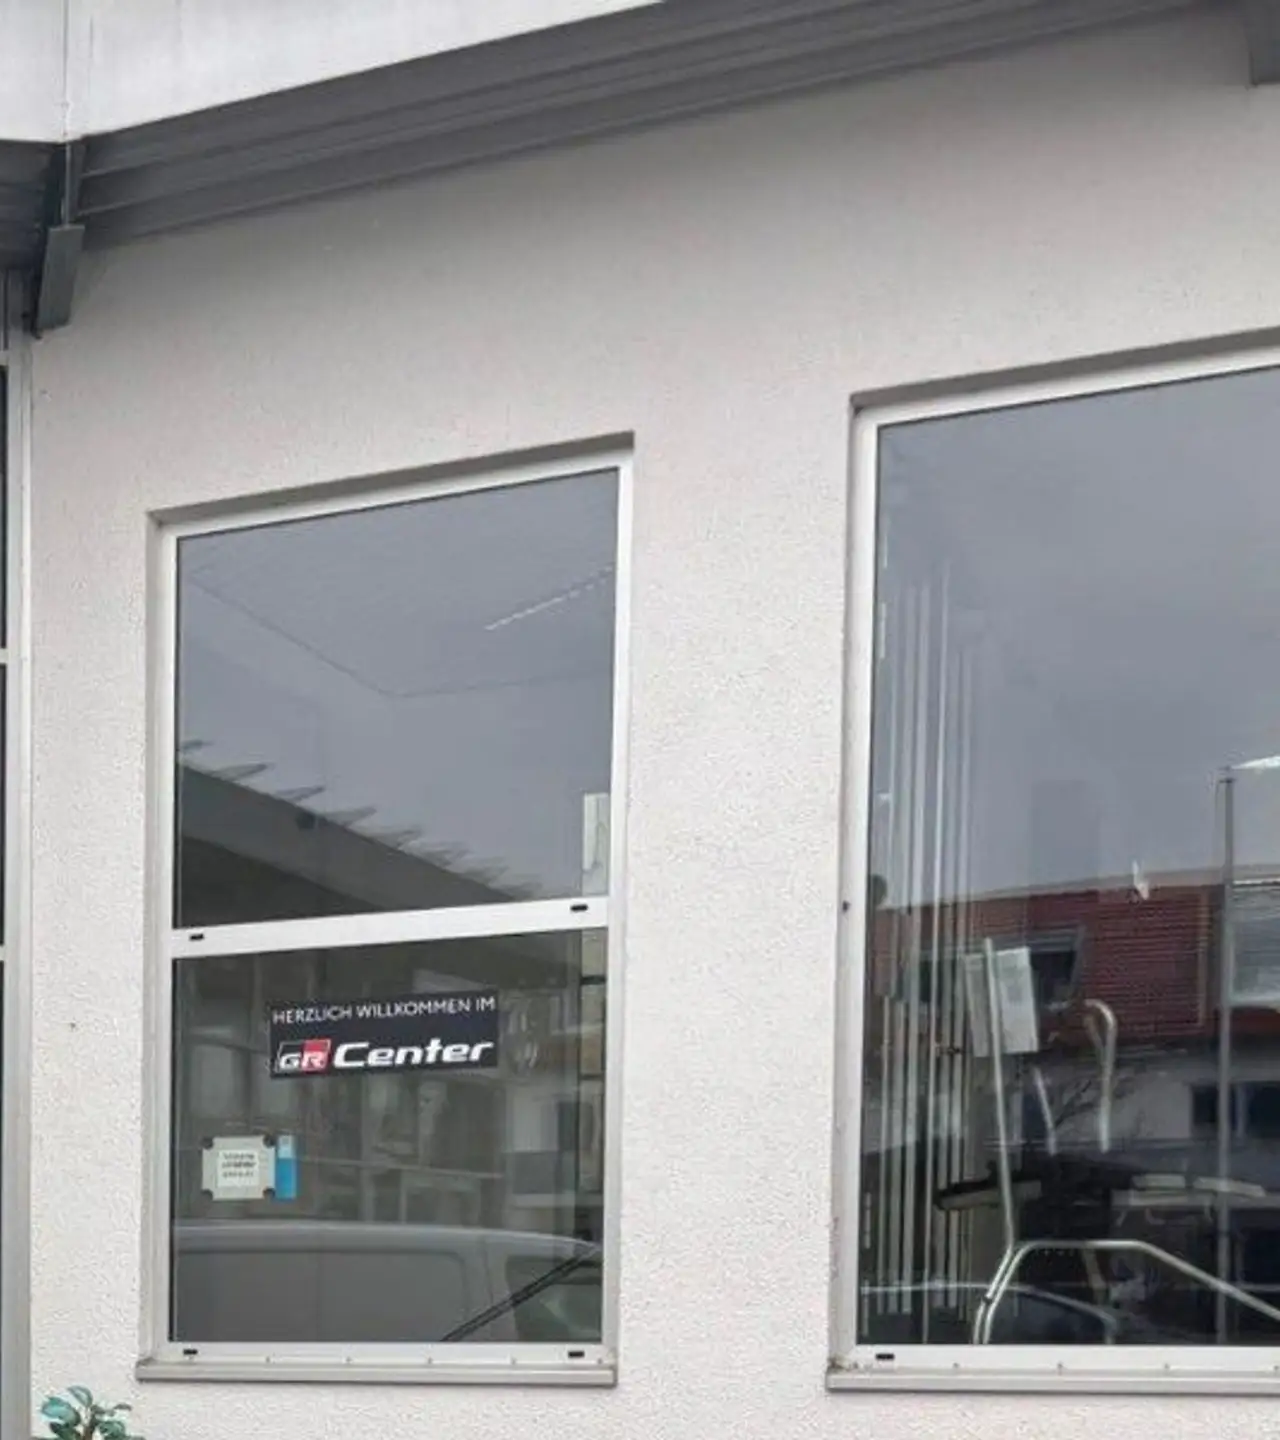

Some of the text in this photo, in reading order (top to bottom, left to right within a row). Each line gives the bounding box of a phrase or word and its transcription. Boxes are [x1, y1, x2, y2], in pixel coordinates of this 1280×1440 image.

[272, 996, 496, 1024] HERZLICH WILLKOMMEN IM
[333, 1037, 495, 1069] Center
